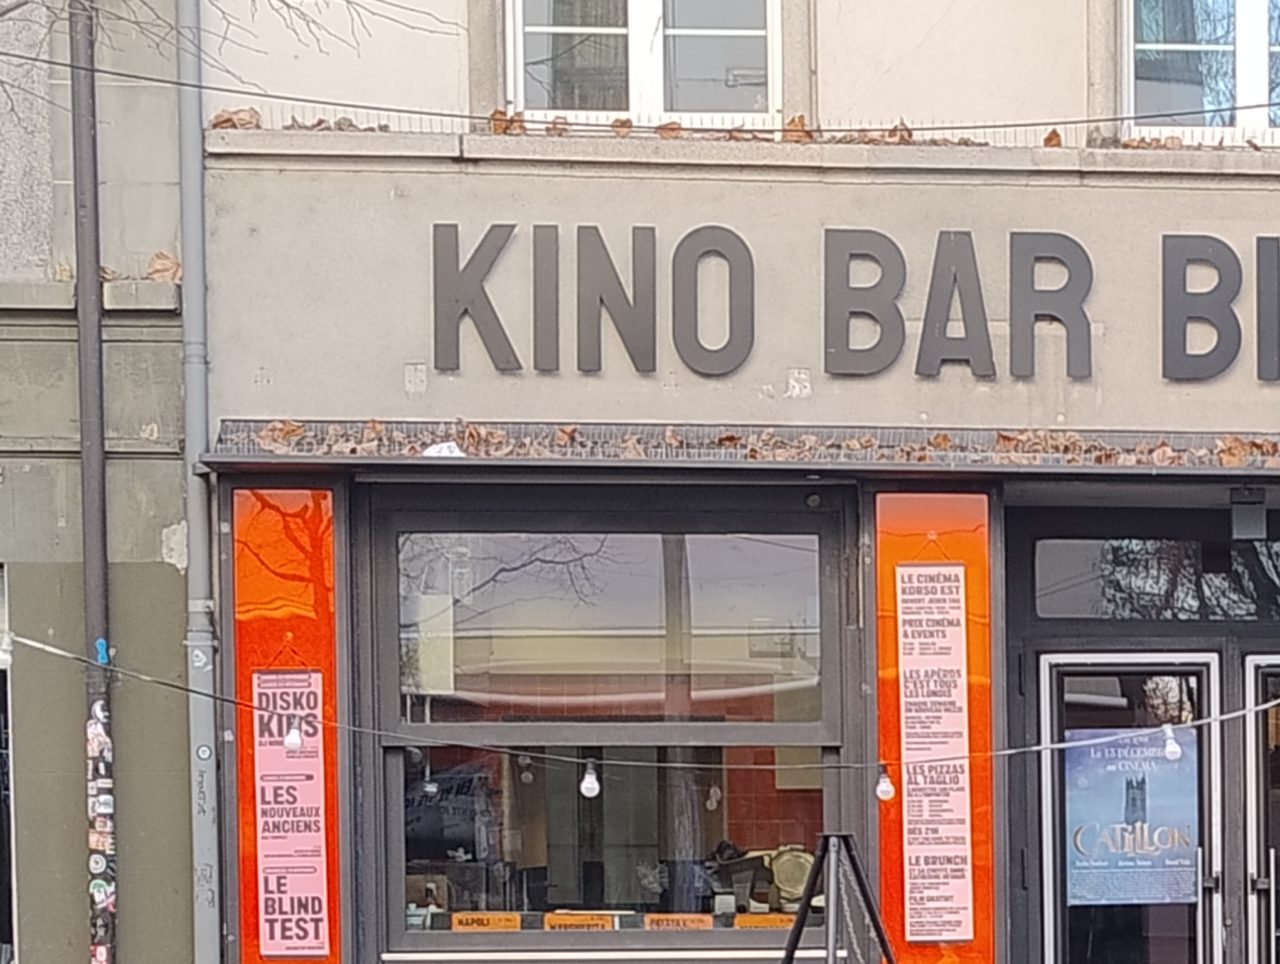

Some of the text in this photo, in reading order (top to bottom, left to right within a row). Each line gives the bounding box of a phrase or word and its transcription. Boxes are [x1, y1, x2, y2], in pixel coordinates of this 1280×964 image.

[432, 222, 755, 377] KINO
[822, 227, 1094, 379] BAR
[901, 572, 960, 584] LE CINÉMA
[901, 586, 960, 596] KORSO EST
[902, 617, 961, 628] PRIX CINÉMA
[911, 630, 947, 639] EVENTS
[903, 667, 962, 679] LES APÉROS
[904, 680, 958, 689] C'EST TOUS
[904, 689, 952, 698] LES LUNDIS
[258, 691, 318, 711] DISKO
[906, 764, 965, 775] LES PIZZAS
[907, 775, 960, 785] AL TAGLIO
[261, 786, 298, 805] LES
[261, 807, 320, 819] NOUVEAUX
[261, 820, 321, 834] ANCIENS
[909, 856, 968, 866] LE BRUNCH
[264, 876, 288, 895] LE
[265, 896, 323, 916] BLIND
[458, 917, 491, 927] NAPOLI
[265, 918, 324, 941] TEST
